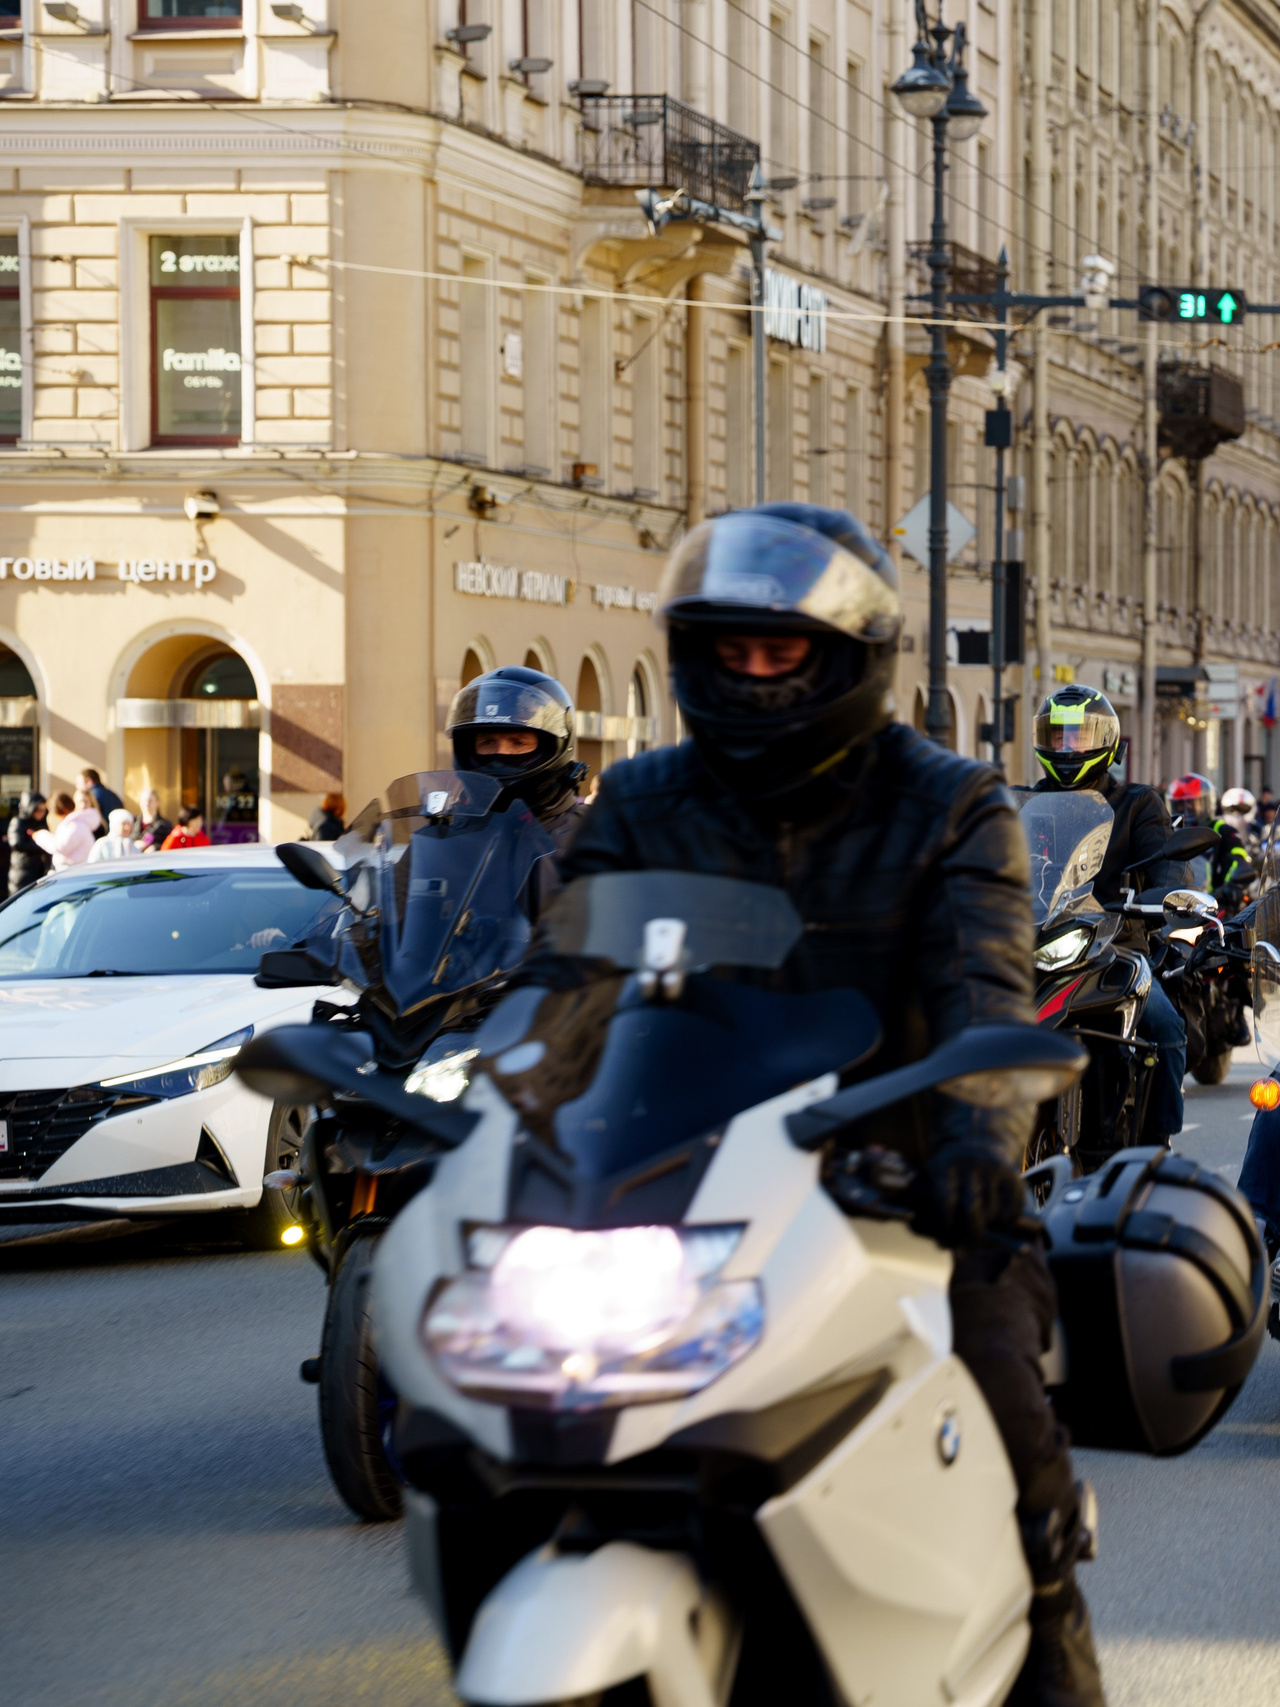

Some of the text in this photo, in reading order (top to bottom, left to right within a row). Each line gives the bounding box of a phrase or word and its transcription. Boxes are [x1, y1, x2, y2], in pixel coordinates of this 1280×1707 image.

[160, 250, 240, 273] 2 этаж
[1180, 293, 1206, 318] 31
[162, 347, 242, 372] familia
[117, 558, 217, 588] центр
